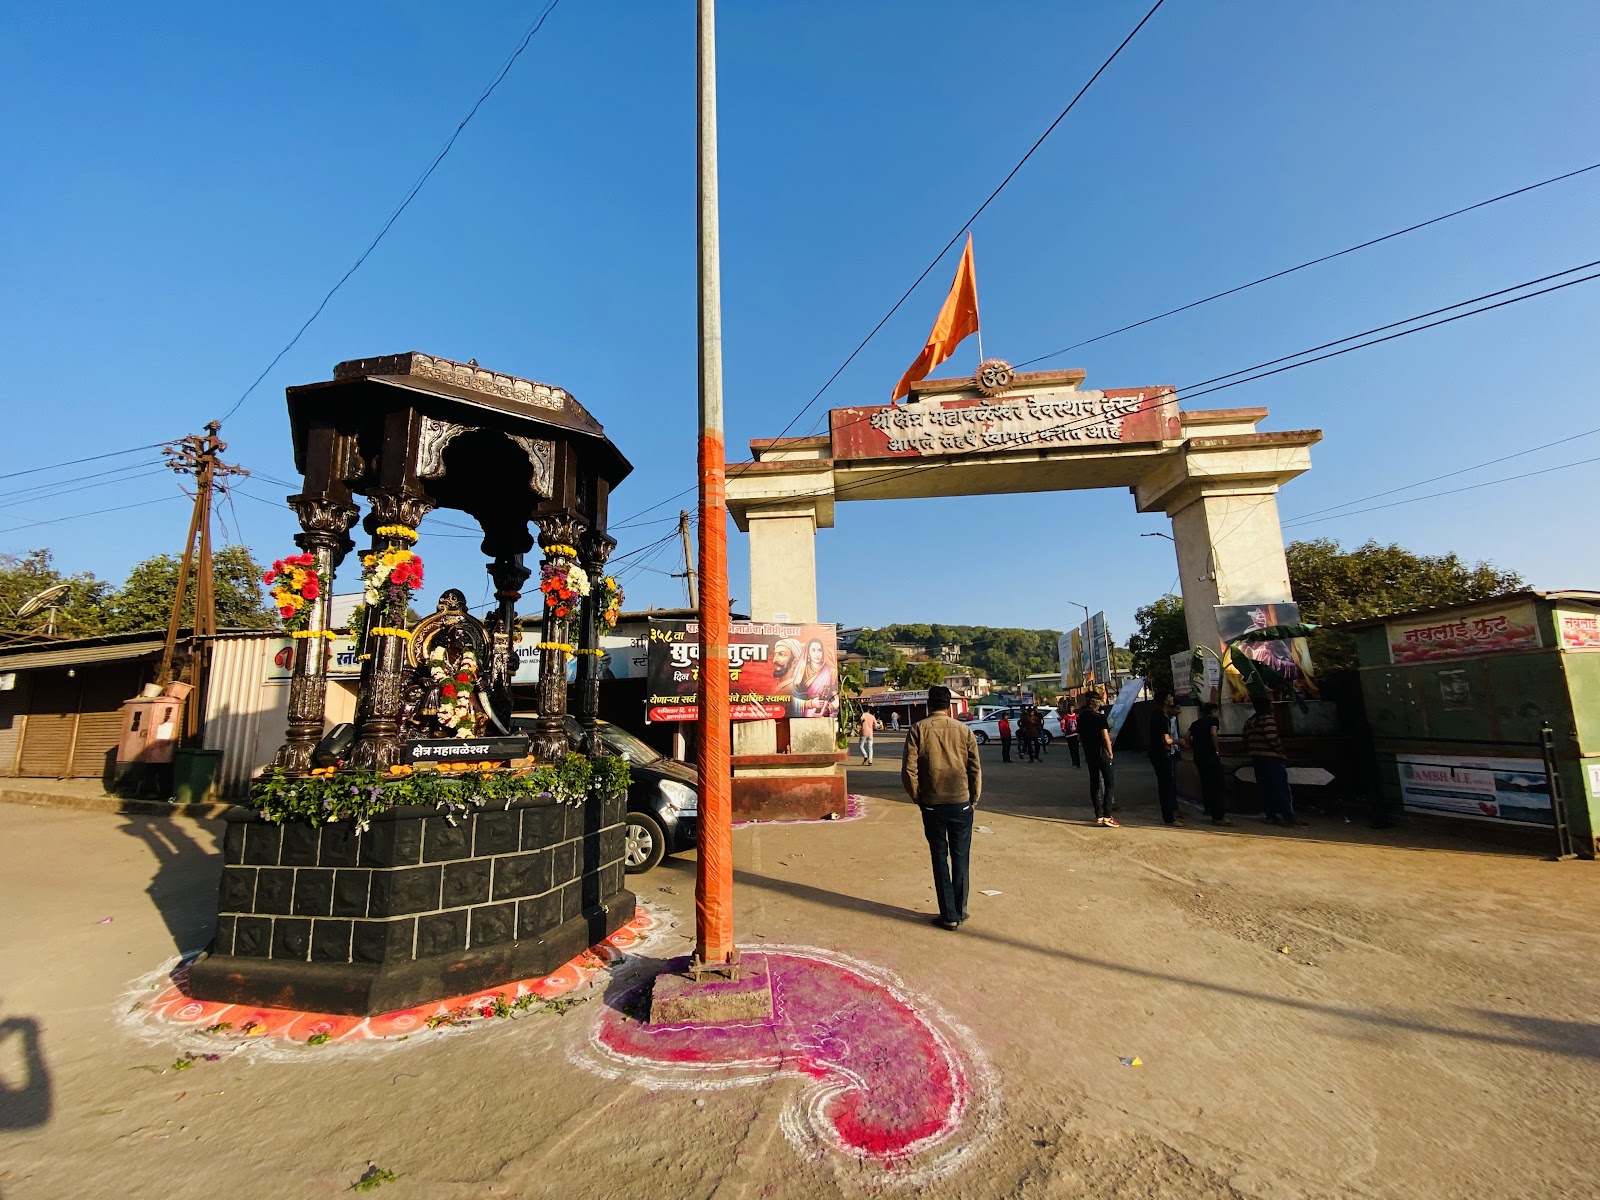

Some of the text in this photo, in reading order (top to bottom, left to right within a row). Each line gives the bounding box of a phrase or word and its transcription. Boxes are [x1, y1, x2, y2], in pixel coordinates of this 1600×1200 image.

[869, 408, 891, 429] श्री
[893, 407, 925, 429] क्षेत्र
[1025, 396, 1099, 420] देवस्थान
[887, 432, 935, 452] आपले
[1085, 418, 1122, 440] आहे
[1403, 617, 1469, 642] नवलाई
[412, 743, 490, 758] क्षेत्र महाबळेश्वर
